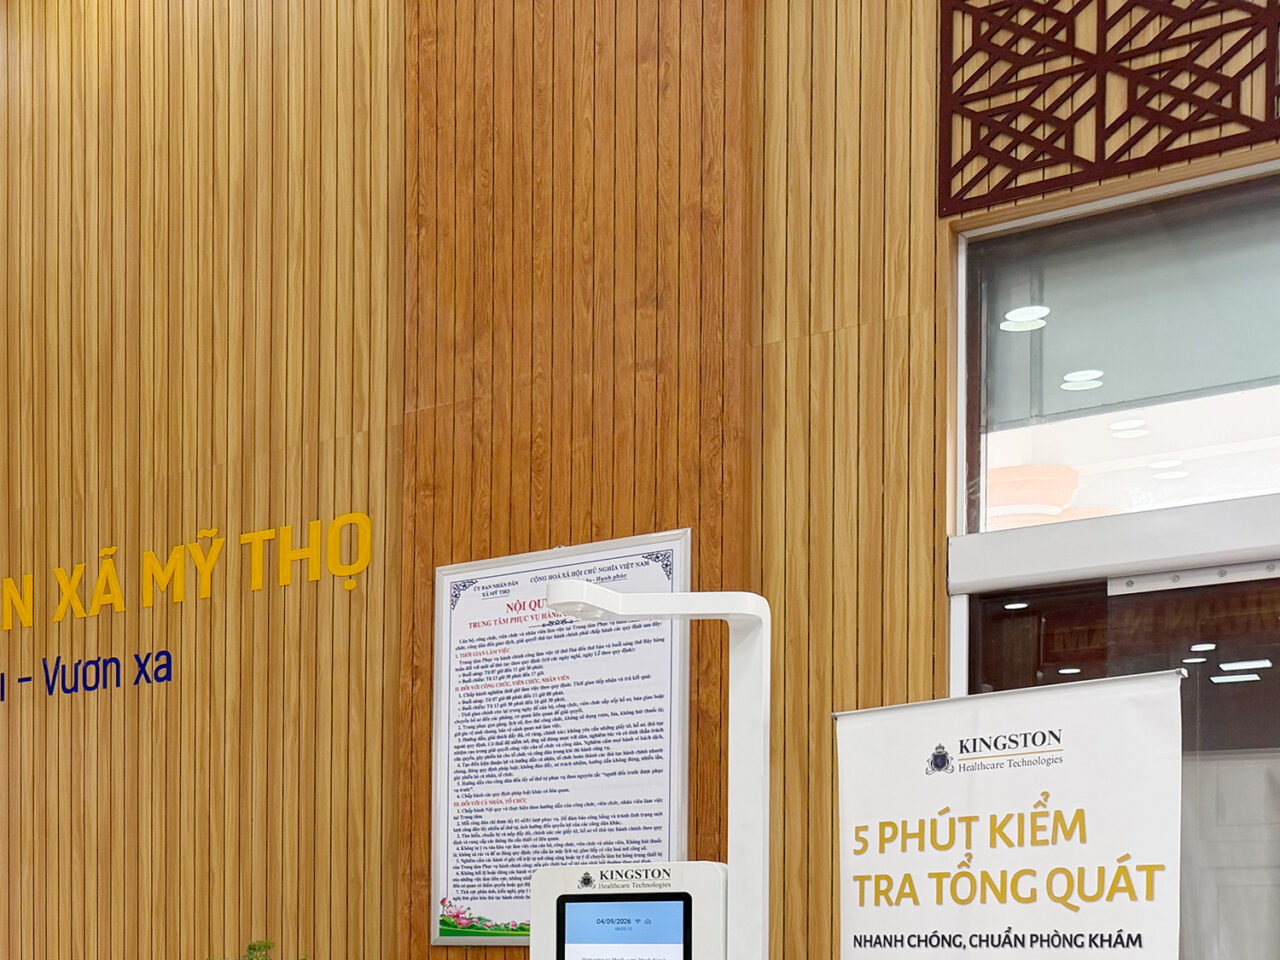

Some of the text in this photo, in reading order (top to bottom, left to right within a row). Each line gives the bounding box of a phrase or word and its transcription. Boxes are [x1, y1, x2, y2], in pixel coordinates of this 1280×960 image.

[51, 546, 126, 623] XÃ
[142, 528, 225, 609] MỸ
[240, 511, 372, 591] THỌ
[619, 562, 634, 570] VIỆT
[506, 598, 548, 615] NỘI QU
[468, 621, 491, 629] TRUNG
[494, 617, 508, 626] TÂM
[510, 615, 529, 625] PHỤC
[530, 613, 540, 621] VỤ
[42, 655, 121, 698] Vươn
[132, 649, 173, 687] xa
[959, 729, 1062, 754] KINGSTON
[959, 756, 1063, 773] Healthcare Technologies
[853, 791, 1087, 856] 5 PHÚT KIỂM
[599, 868, 671, 880] KINGSTON
[853, 852, 1166, 913] TRA TỔNG QUÁT
[631, 881, 671, 890] Technologies
[853, 926, 1143, 950] NHANH CHÓNG, CHUẨN PHÒNG KHÁM
